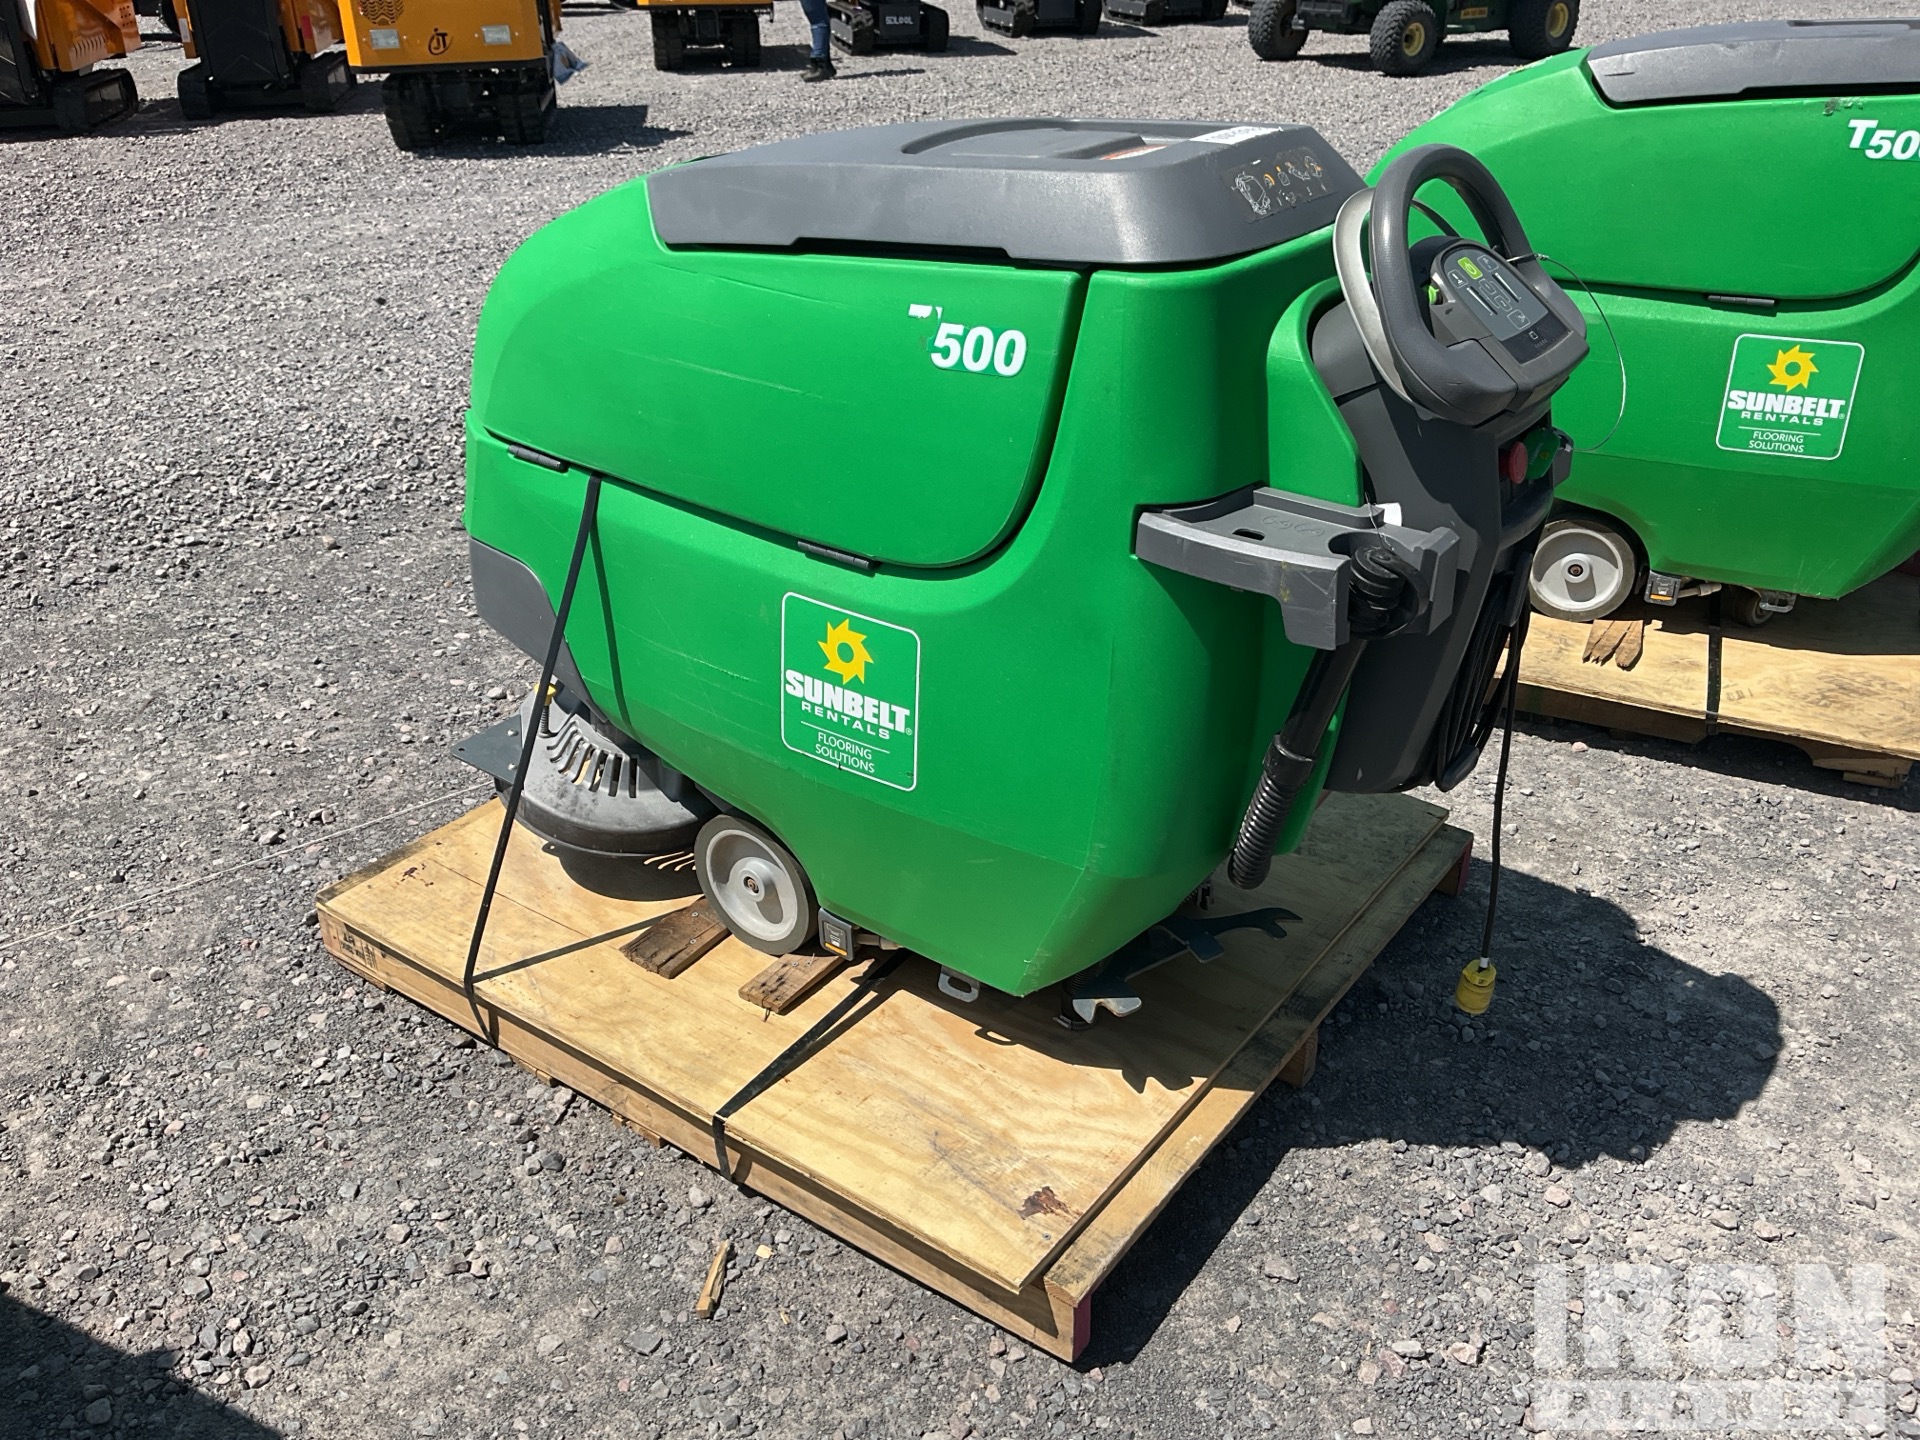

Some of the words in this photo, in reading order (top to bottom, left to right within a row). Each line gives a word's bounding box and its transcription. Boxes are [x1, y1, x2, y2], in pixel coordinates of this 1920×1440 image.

[1848, 118, 1920, 160] T50
[1740, 410, 1824, 426] RENTALS
[1748, 440, 1805, 454] SOLUTIONS
[1752, 430, 1804, 444] FLOORING
[801, 700, 890, 740] RENTALS
[815, 743, 875, 774] SOLUTIONS
[817, 731, 872, 760] FLOORING
